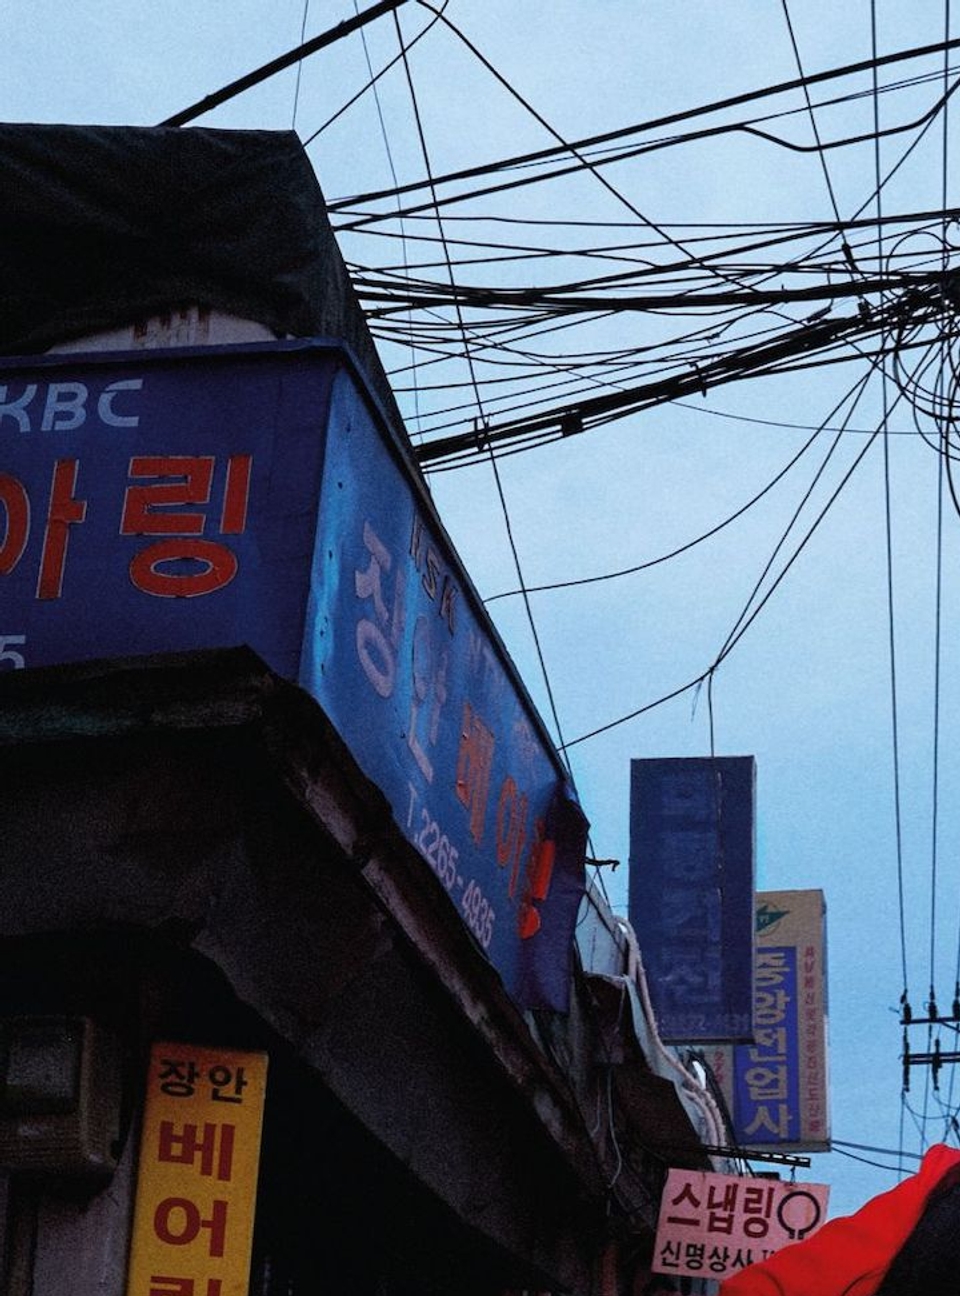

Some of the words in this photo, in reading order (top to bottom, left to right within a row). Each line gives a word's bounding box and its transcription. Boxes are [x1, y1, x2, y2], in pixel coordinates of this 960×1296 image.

[157, 1058, 248, 1104] 장안
[667, 1182, 776, 1239] 스냅링
[660, 1240, 753, 1273] 신명상사
